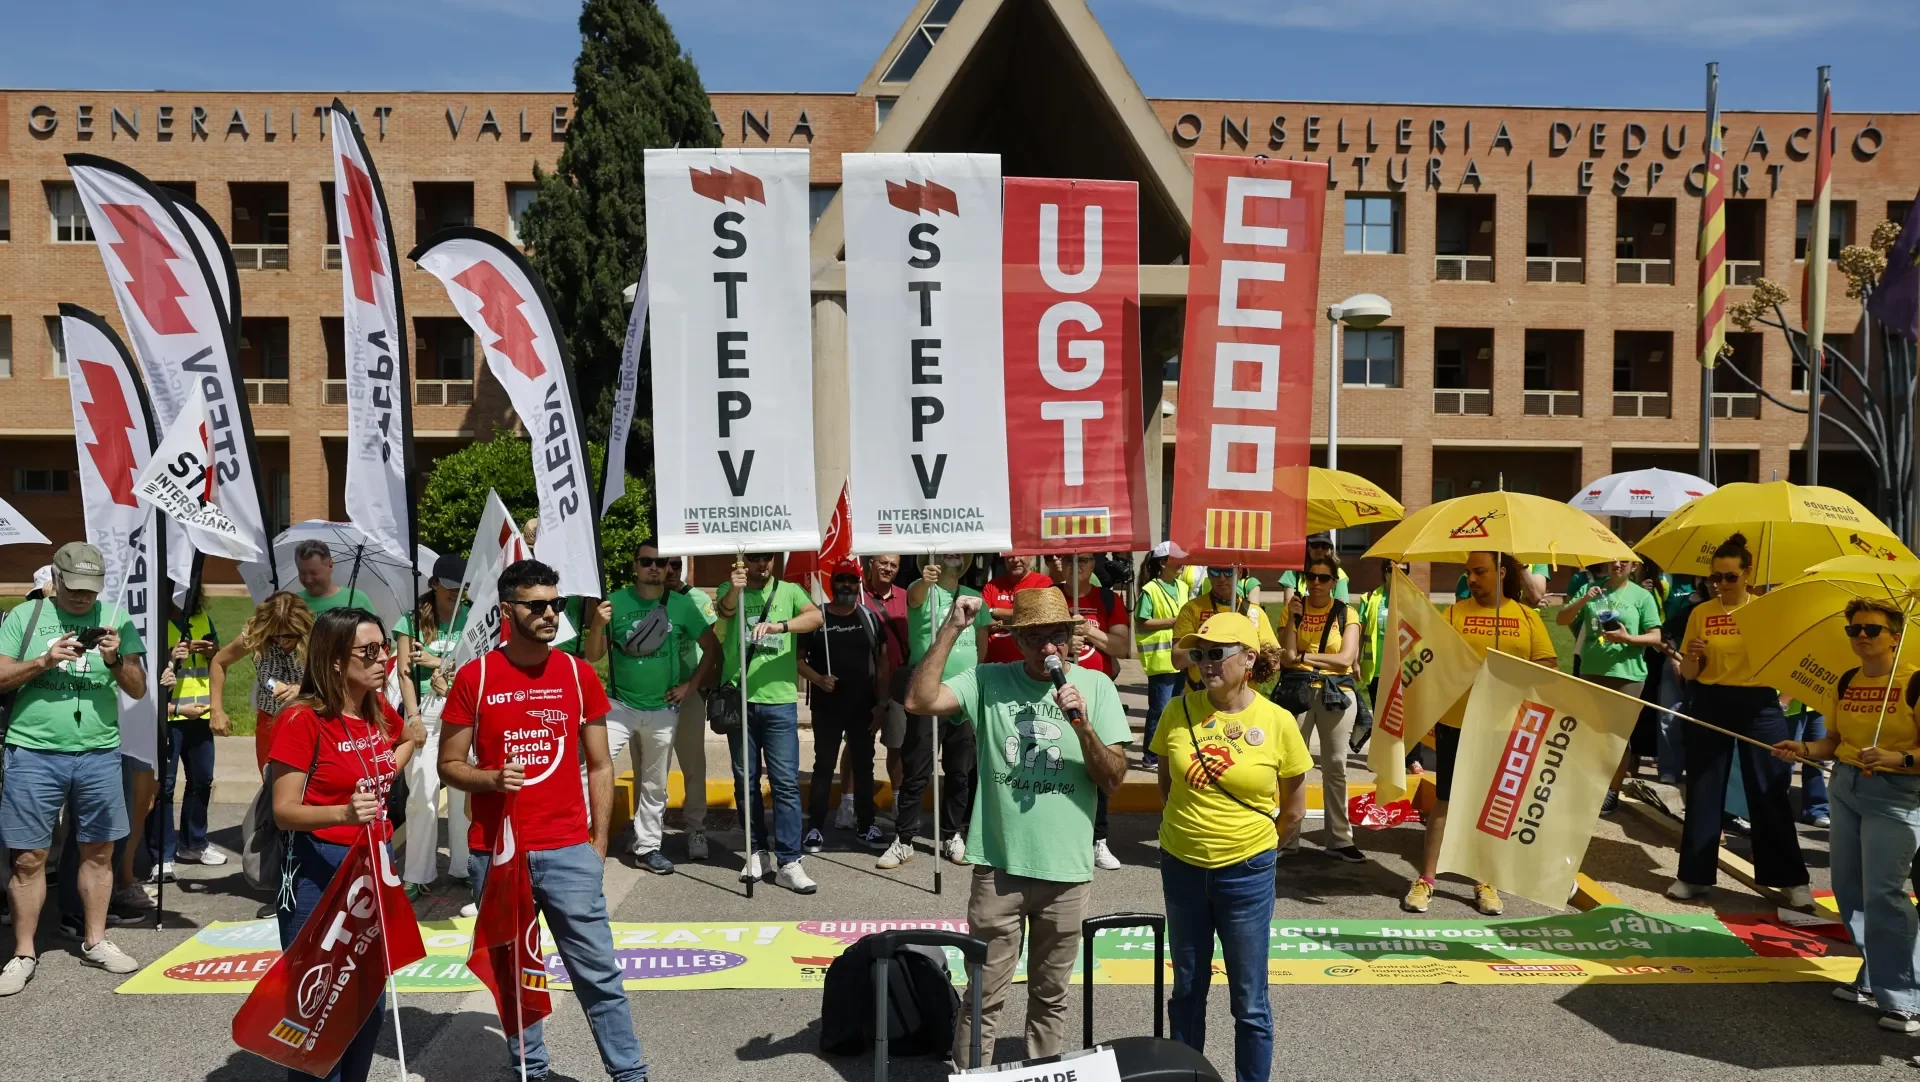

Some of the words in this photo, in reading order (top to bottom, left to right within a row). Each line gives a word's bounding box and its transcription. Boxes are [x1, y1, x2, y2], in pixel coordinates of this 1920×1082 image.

[445, 105, 813, 136] VALEANA
[1176, 113, 1513, 147] ONSELLERIA
[1553, 116, 1885, 155] D'EDUACIÓ
[1291, 154, 1482, 185] LTURA
[1208, 176, 1292, 492] CCOO
[1038, 203, 1105, 486] UGT
[713, 211, 755, 497] STEPV
[908, 222, 948, 500] STEPV
[684, 505, 792, 520] INTERSINDICAL
[877, 507, 984, 521] INTERSINDICAL
[1803, 500, 1855, 515] educació
[1838, 513, 1860, 523] lluita
[702, 519, 793, 534] VALENCIANA
[895, 521, 984, 535] VALENCIANA
[487, 692, 513, 706] UGT
[1008, 703, 1067, 722] ESTIME
[504, 728, 549, 742] Salvem
[504, 741, 552, 754] l'escola
[1033, 780, 1076, 796] PÚBLICA
[1366, 926, 1574, 938] -burocràcia
[1272, 939, 1449, 953] +plantilla
[1613, 965, 1668, 974] UGT
